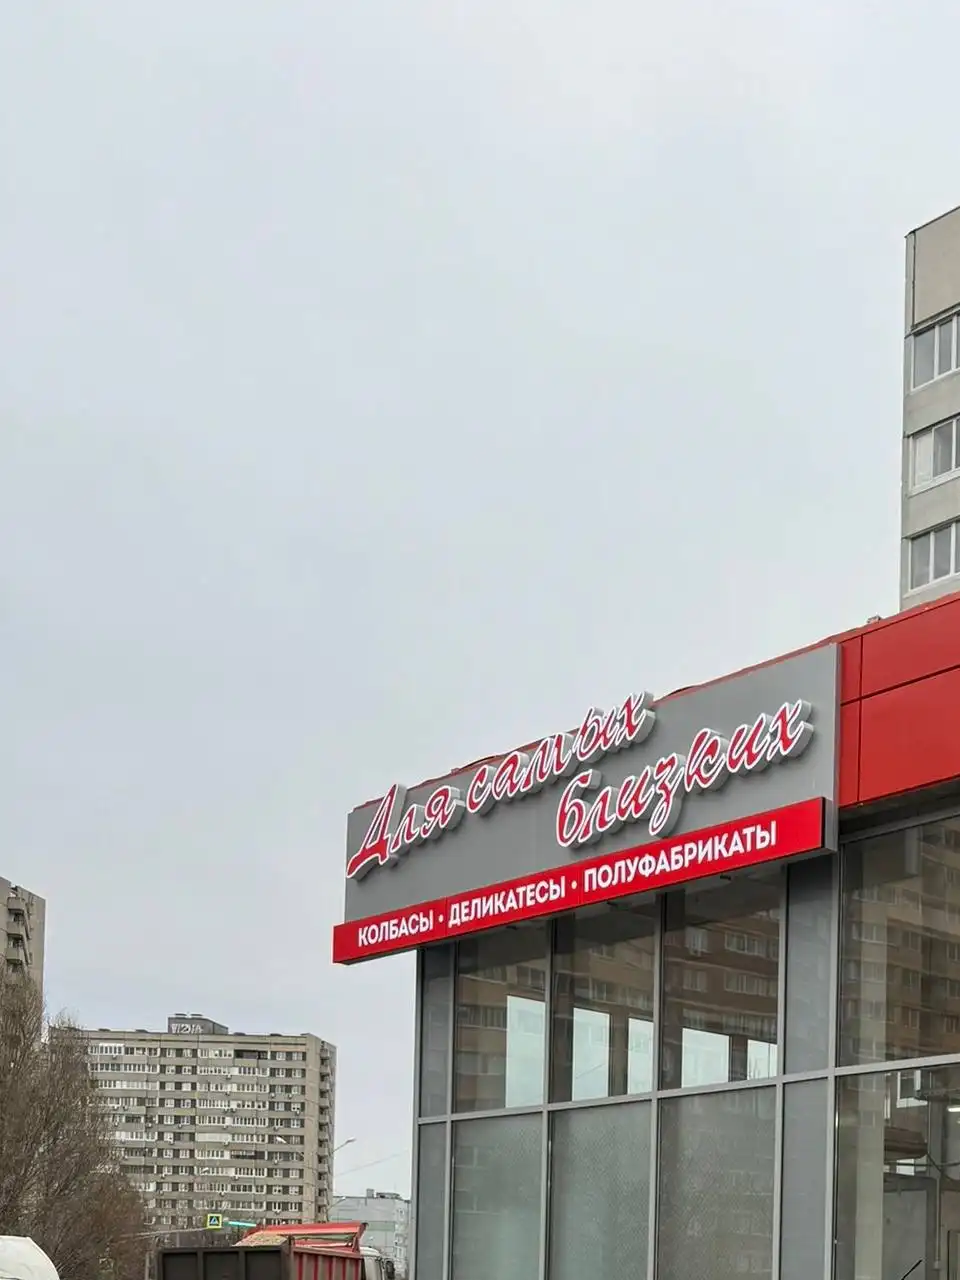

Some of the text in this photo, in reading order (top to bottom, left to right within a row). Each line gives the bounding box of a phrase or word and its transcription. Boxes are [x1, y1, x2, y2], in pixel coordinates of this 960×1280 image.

[346, 690, 655, 881] Для самых
[554, 698, 814, 849] близких
[357, 820, 778, 948] КОЛБАСЫ ДЕЛИКАТЕСЫ ПОЛУФАБРИКАТЫ
